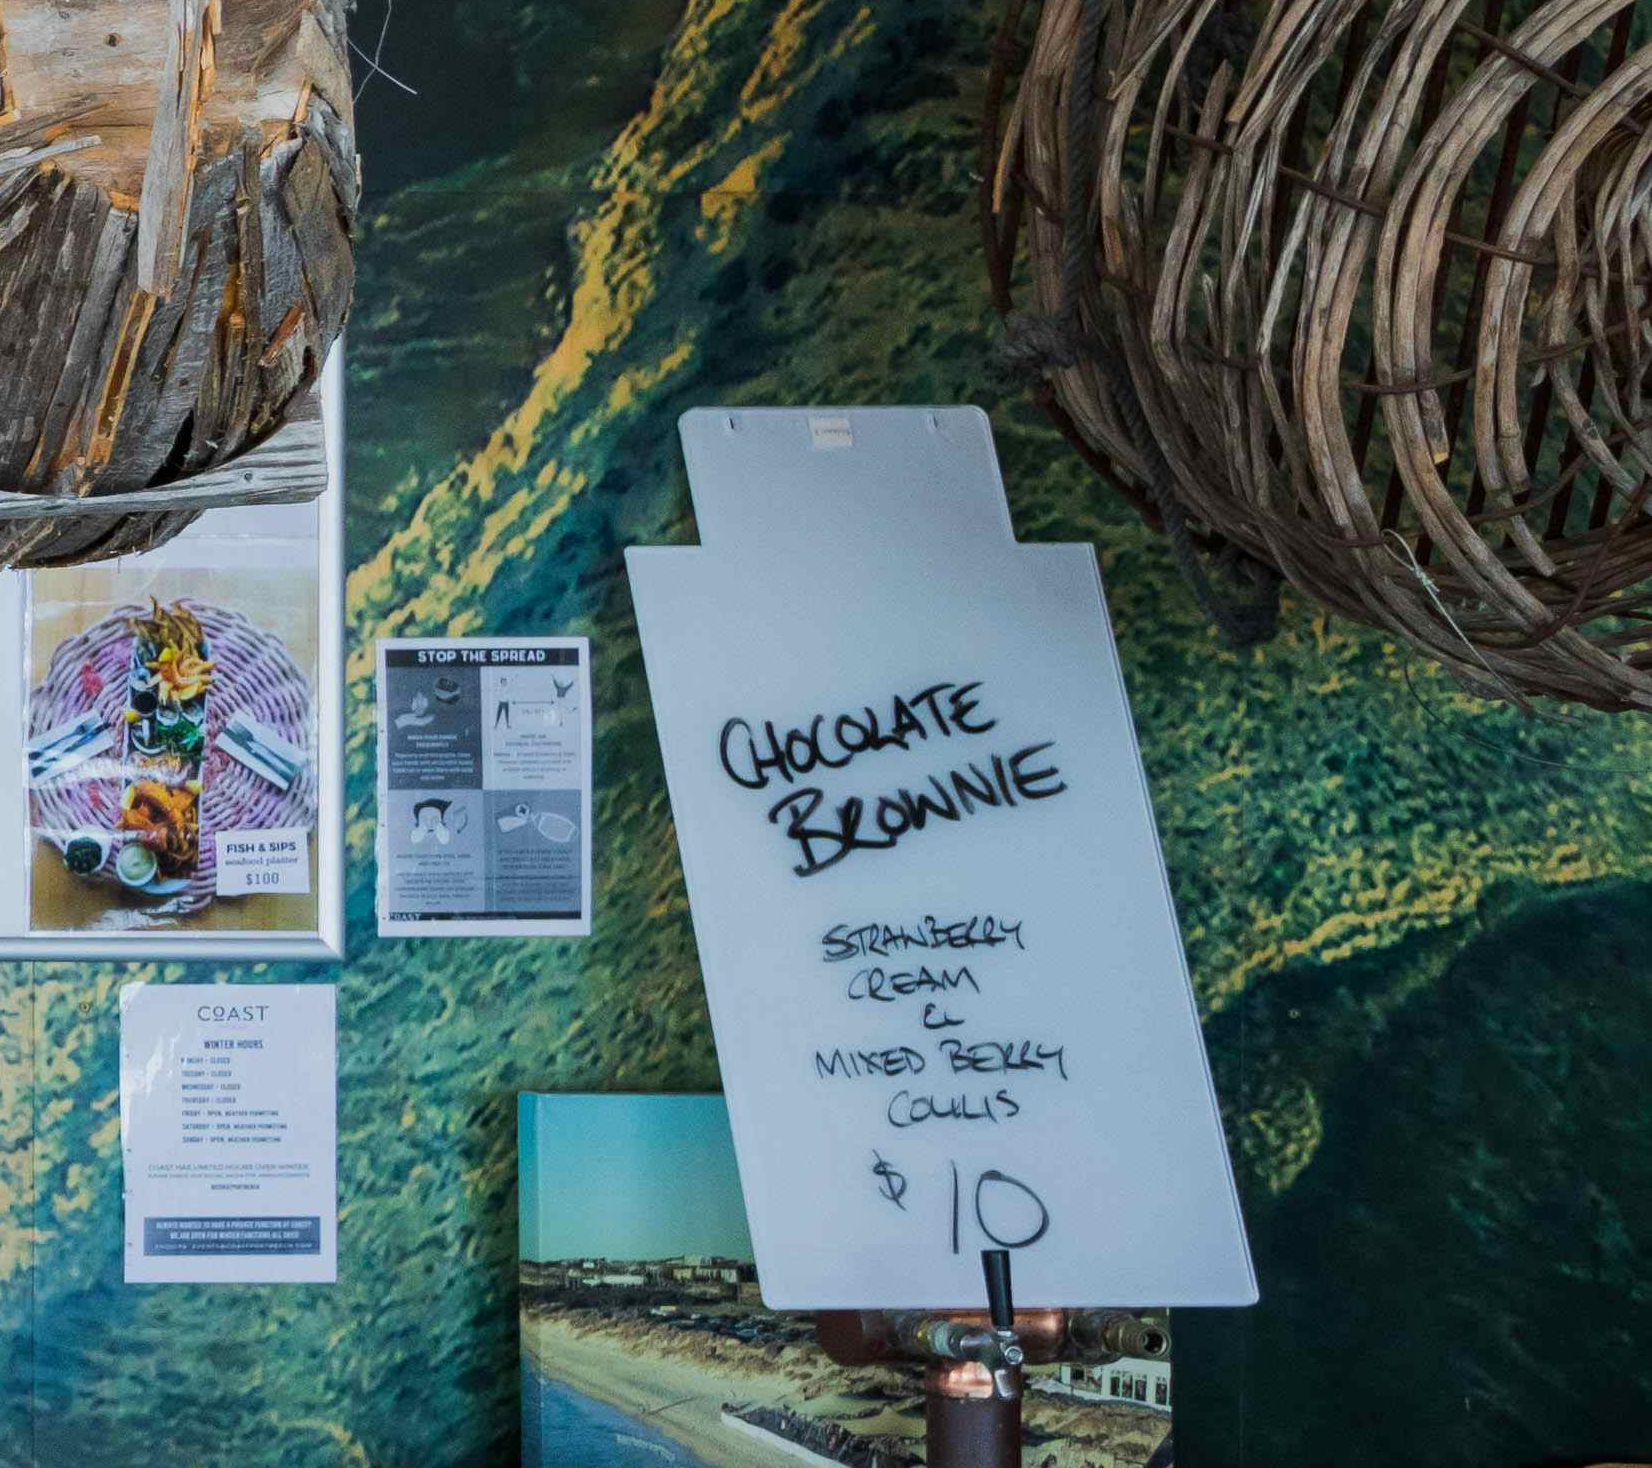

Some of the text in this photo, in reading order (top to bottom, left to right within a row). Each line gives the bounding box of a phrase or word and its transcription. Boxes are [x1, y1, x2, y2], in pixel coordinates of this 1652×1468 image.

[417, 649, 546, 664] STOP THE SPREAD
[718, 681, 996, 790] CHOCOLATE
[768, 742, 1067, 877] BROWNIE
[226, 841, 297, 853] FISH & SIPS
[246, 872, 280, 886] $100
[847, 966, 981, 1002] CREAM
[197, 1005, 270, 1022] COAST
[204, 1040, 264, 1049] WINTER HOURS
[815, 1038, 1069, 1081] MIXED BERRY
[887, 1088, 1021, 1128] COULIS
